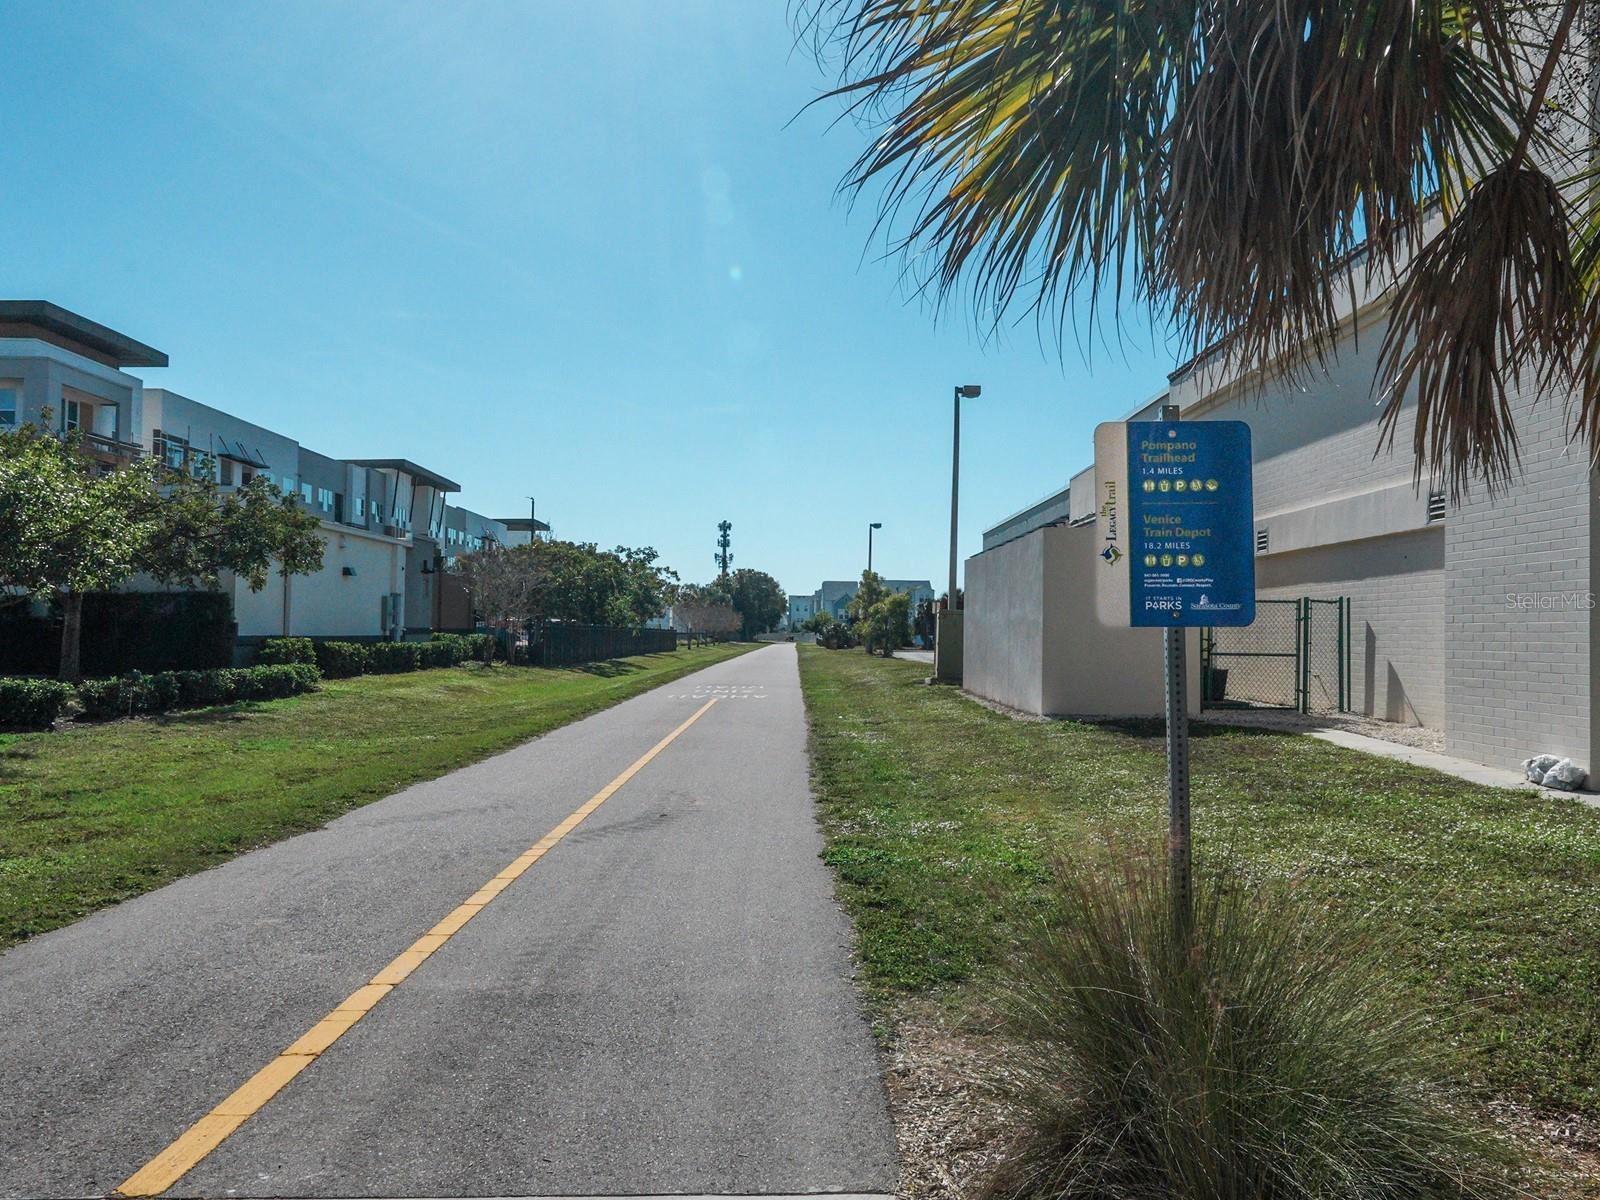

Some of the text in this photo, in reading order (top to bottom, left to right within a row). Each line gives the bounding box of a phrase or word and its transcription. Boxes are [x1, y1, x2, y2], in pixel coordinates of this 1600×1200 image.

[1142, 440, 1197, 451] Pompano
[1142, 453, 1195, 462] Trailhead
[1142, 467, 1184, 475] 1.4 MILES
[1105, 481, 1116, 505] trail
[1143, 514, 1182, 525] Venice
[1143, 528, 1212, 539] Train Depot
[1144, 542, 1191, 550] 18.2 MILES
[1145, 601, 1182, 610] PARKS
